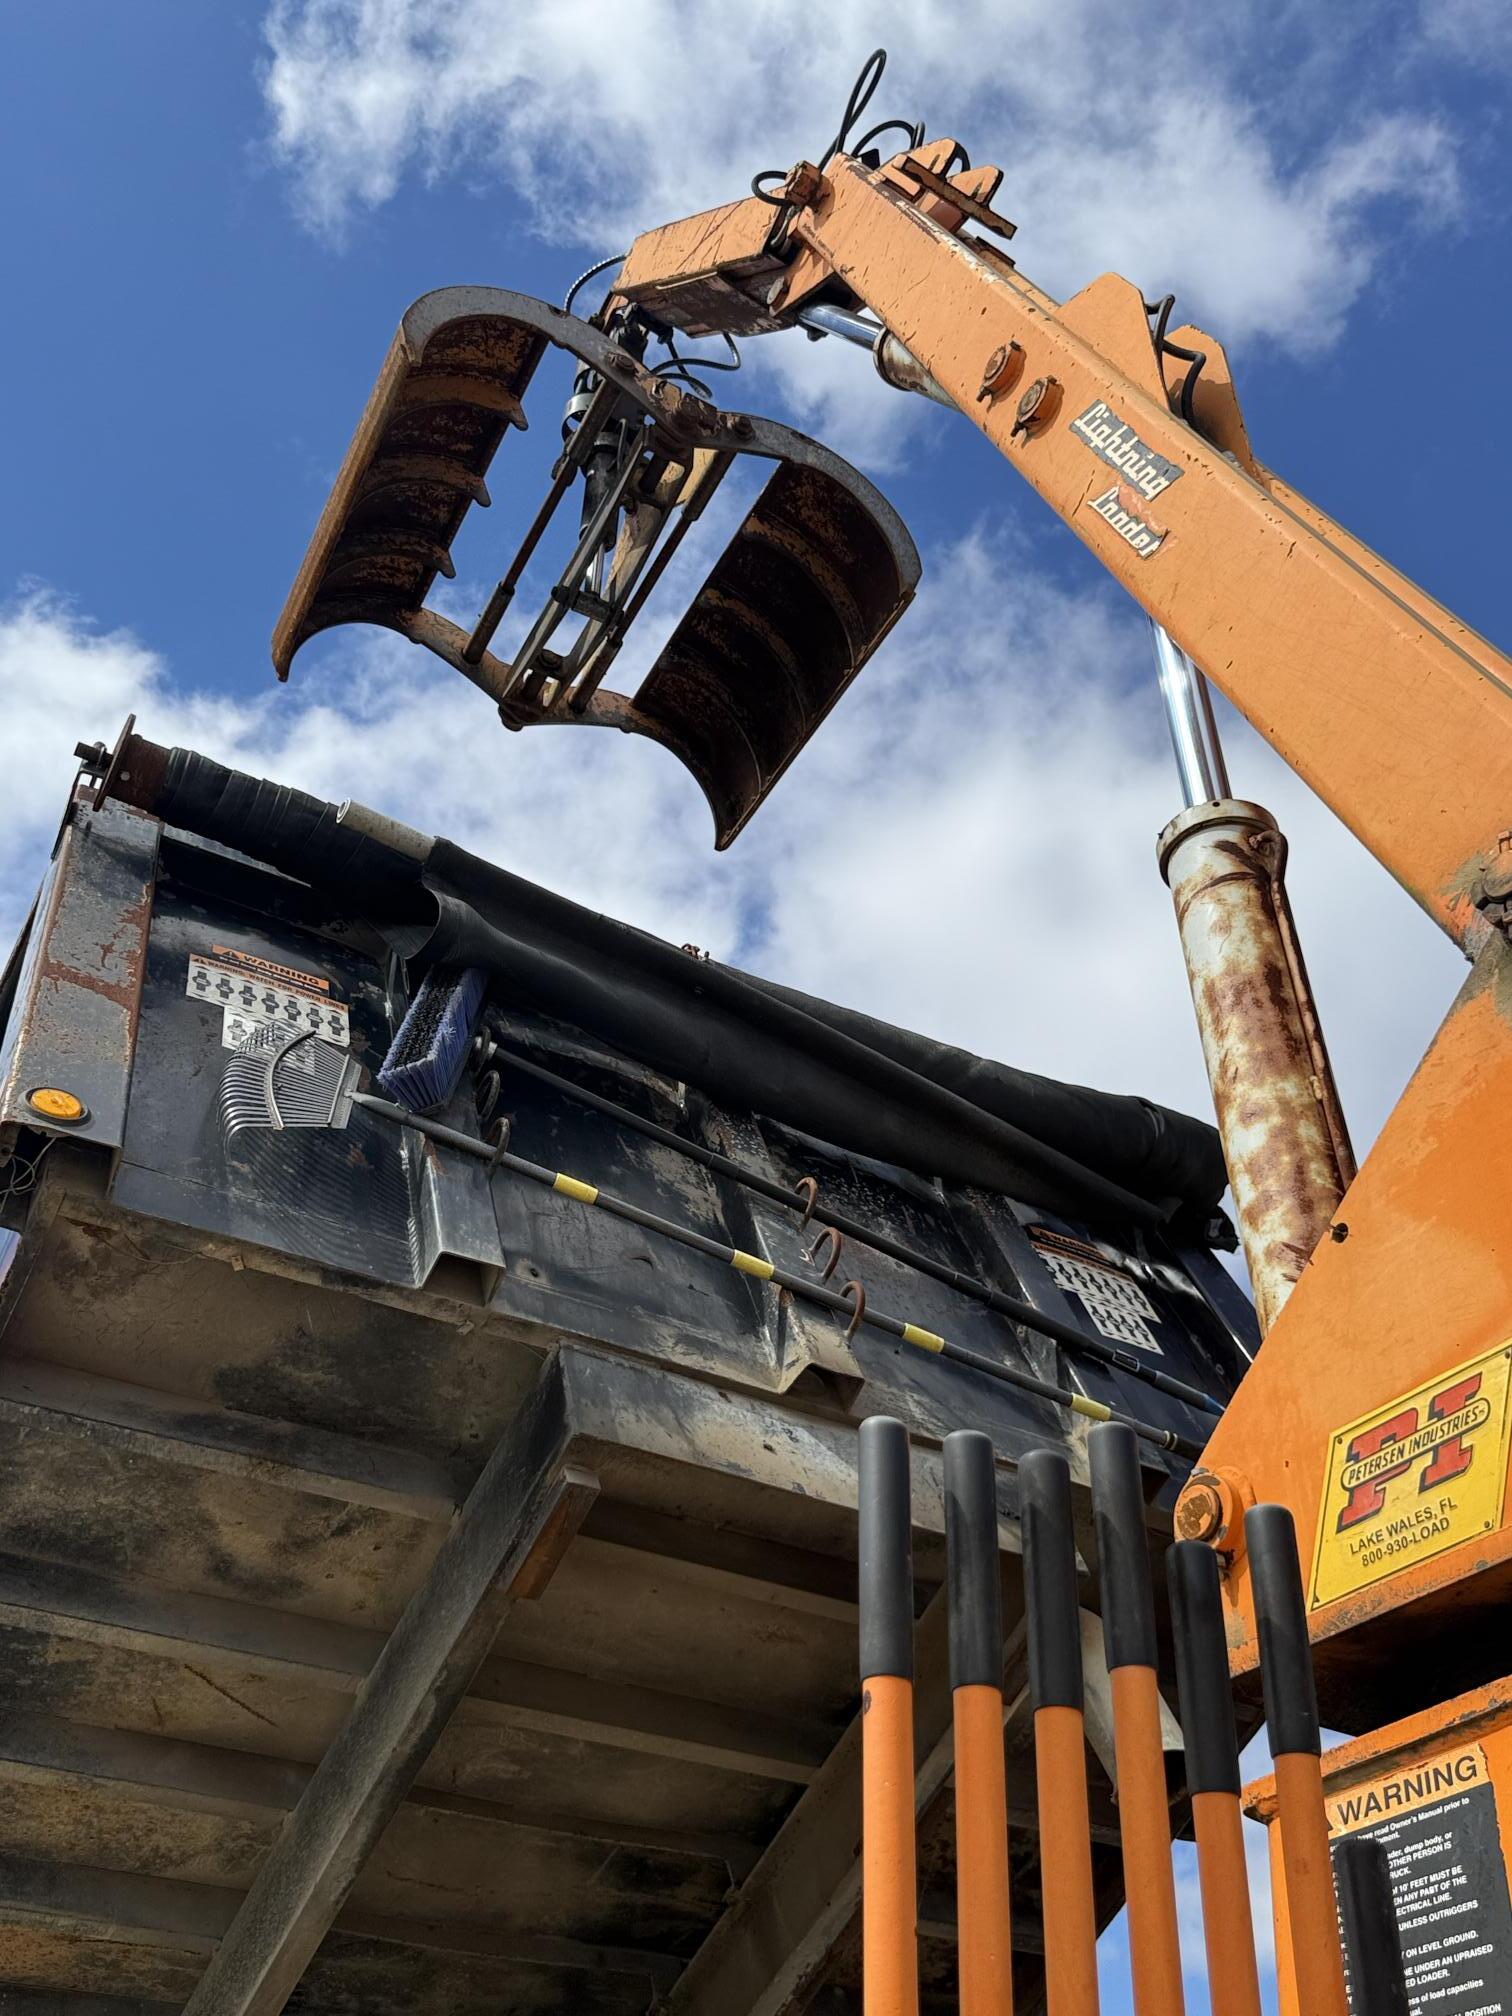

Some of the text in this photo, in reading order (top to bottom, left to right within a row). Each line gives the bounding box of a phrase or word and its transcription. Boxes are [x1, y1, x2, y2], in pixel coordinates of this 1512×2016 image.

[244, 956, 320, 986] WARNING
[1348, 1405, 1479, 1486] PETERSEN INDUSTRIES
[1350, 1497, 1458, 1555] LAKE WALES, FL
[1362, 1517, 1450, 1567] 800-930-LOAD
[1337, 1755, 1477, 1825] WARNING
[1418, 1805, 1443, 1821] Manual
[1444, 1801, 1460, 1814] prior
[1461, 1797, 1470, 1805] to
[1404, 1842, 1424, 1854] dump
[1444, 1832, 1453, 1840] or
[1412, 1844, 1443, 1861] PERSON
[1444, 1841, 1452, 1851] IS
[1390, 1867, 1412, 1880] RUCK.
[1409, 1876, 1429, 1889] FEET
[1429, 1869, 1450, 1883] MUST
[1451, 1864, 1463, 1876] BE
[1404, 1891, 1419, 1903] ANY
[1419, 1884, 1439, 1897] PART
[1440, 1880, 1451, 1891] OF
[1452, 1875, 1468, 1887] THE
[1396, 1898, 1432, 1917] ECTRICAL
[1432, 1892, 1452, 1905] LINE.
[1398, 1900, 1479, 1932] UNLESS OUTRIGGERS
[1406, 1947, 1418, 1958] ON
[1418, 1941, 1443, 1955] LEVEL
[1443, 1930, 1479, 1947] GROUND.
[1414, 1959, 1441, 1974] UNDER
[1441, 1955, 1453, 1966] AN
[1453, 1944, 1494, 1963] UPRAISED
[1416, 1968, 1451, 1985] LOADER.
[1420, 1992, 1429, 2002] of
[1429, 1988, 1446, 2000] load
[1446, 1979, 1484, 1996] capacities
